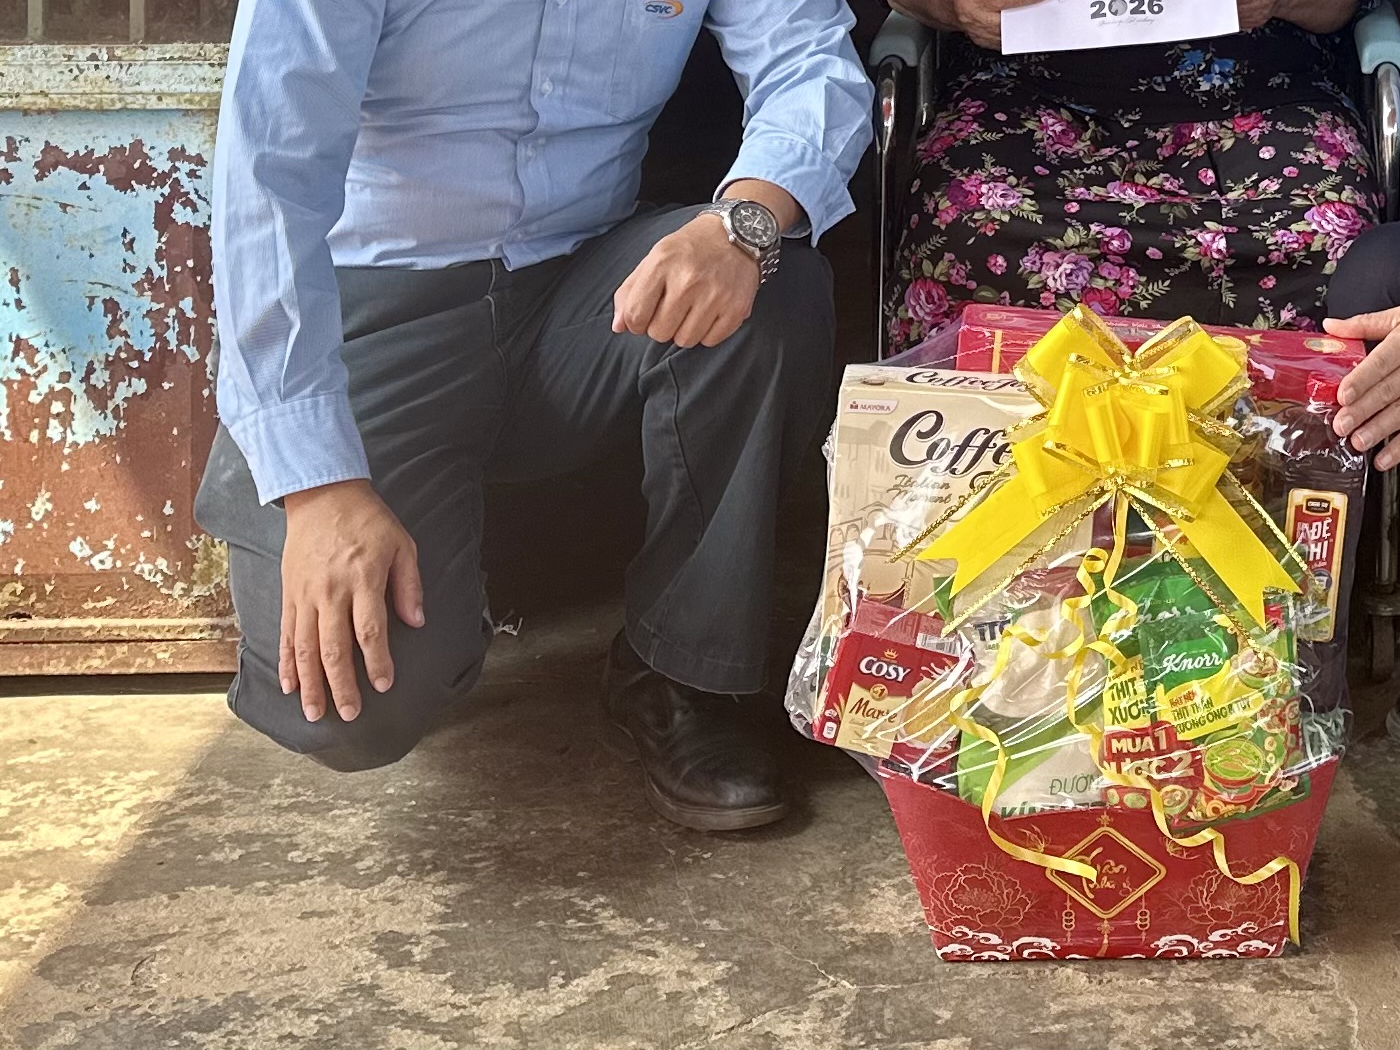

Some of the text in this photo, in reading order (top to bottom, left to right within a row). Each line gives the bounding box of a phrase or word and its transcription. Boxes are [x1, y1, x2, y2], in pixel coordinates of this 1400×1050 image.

[645, 4, 673, 15] CSVC
[860, 404, 892, 412] MAYORA
[889, 410, 1014, 476] Coffe
[859, 655, 912, 682] COSY
[1163, 652, 1224, 672] Knorr
[1111, 729, 1168, 754] MUA 1
[1169, 752, 1196, 778] 2
